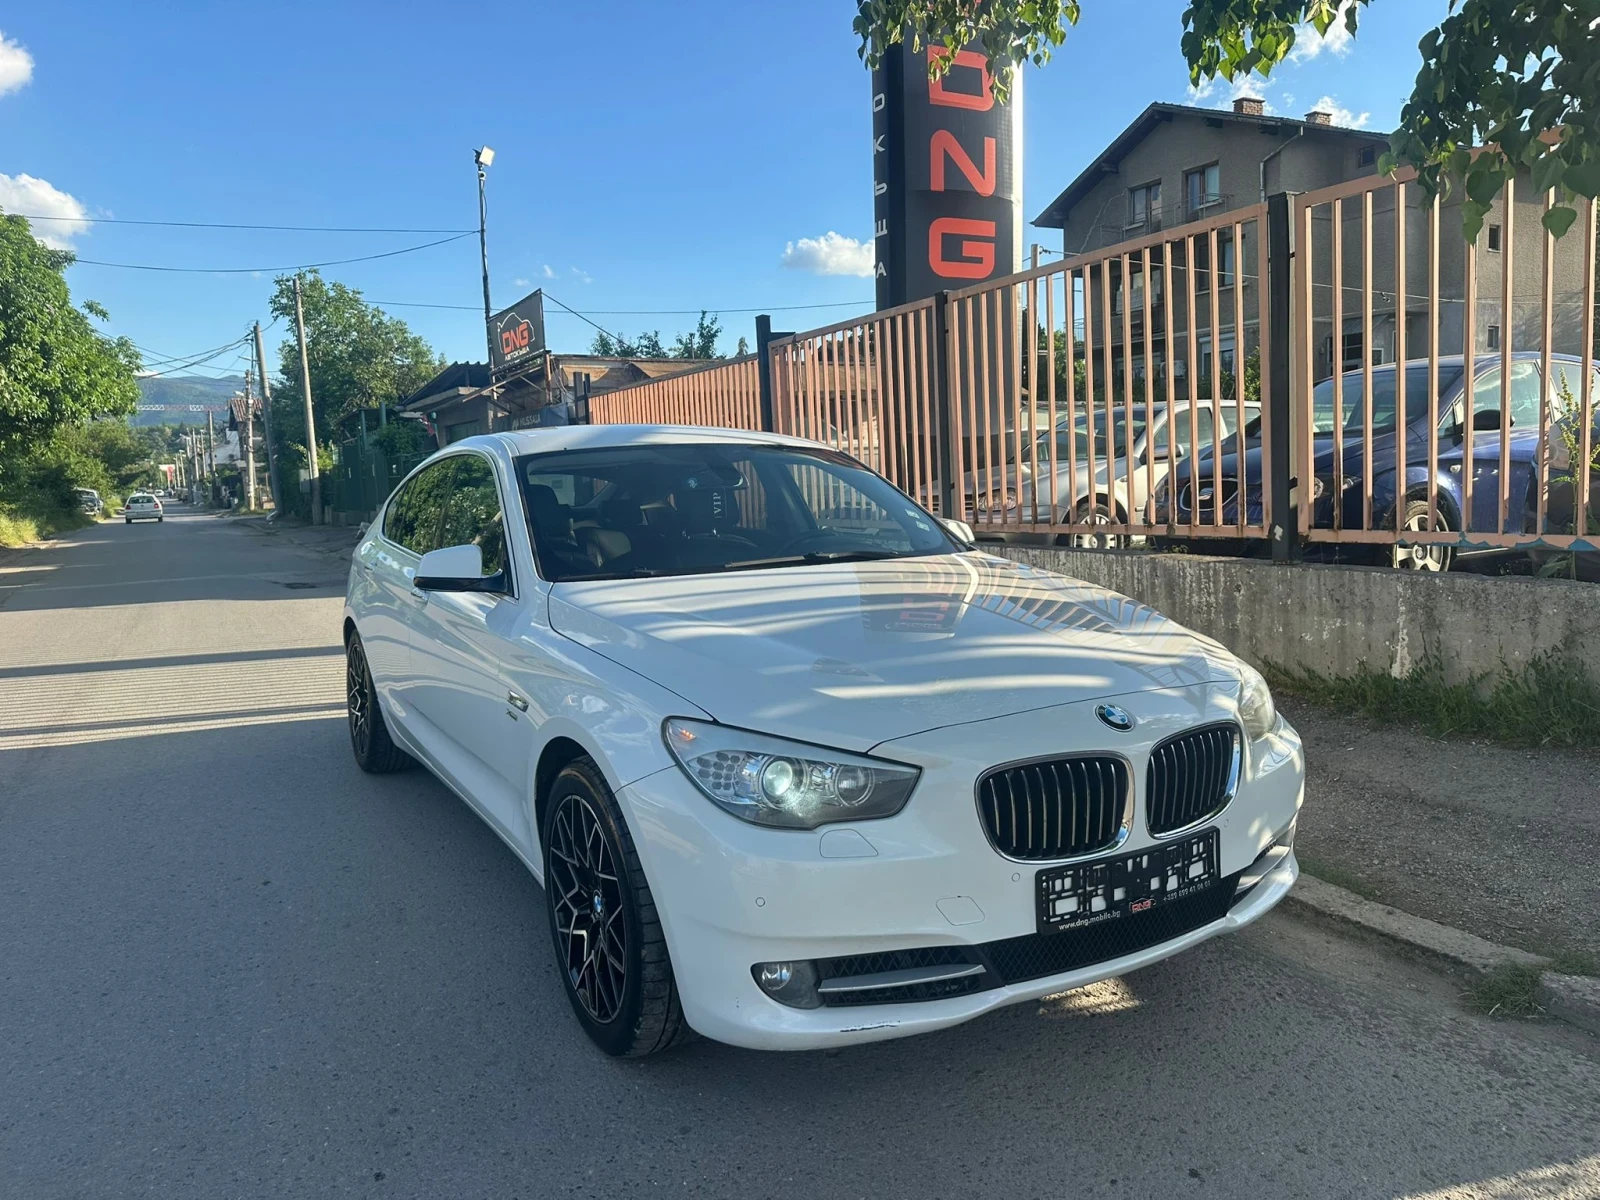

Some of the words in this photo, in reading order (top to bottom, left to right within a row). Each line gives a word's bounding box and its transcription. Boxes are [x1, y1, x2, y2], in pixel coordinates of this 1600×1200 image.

[927, 45, 996, 279] DNG
[502, 322, 529, 354] DNG
[712, 492, 722, 515] VIP
[1058, 910, 1121, 930] www.dng.mobile.bg
